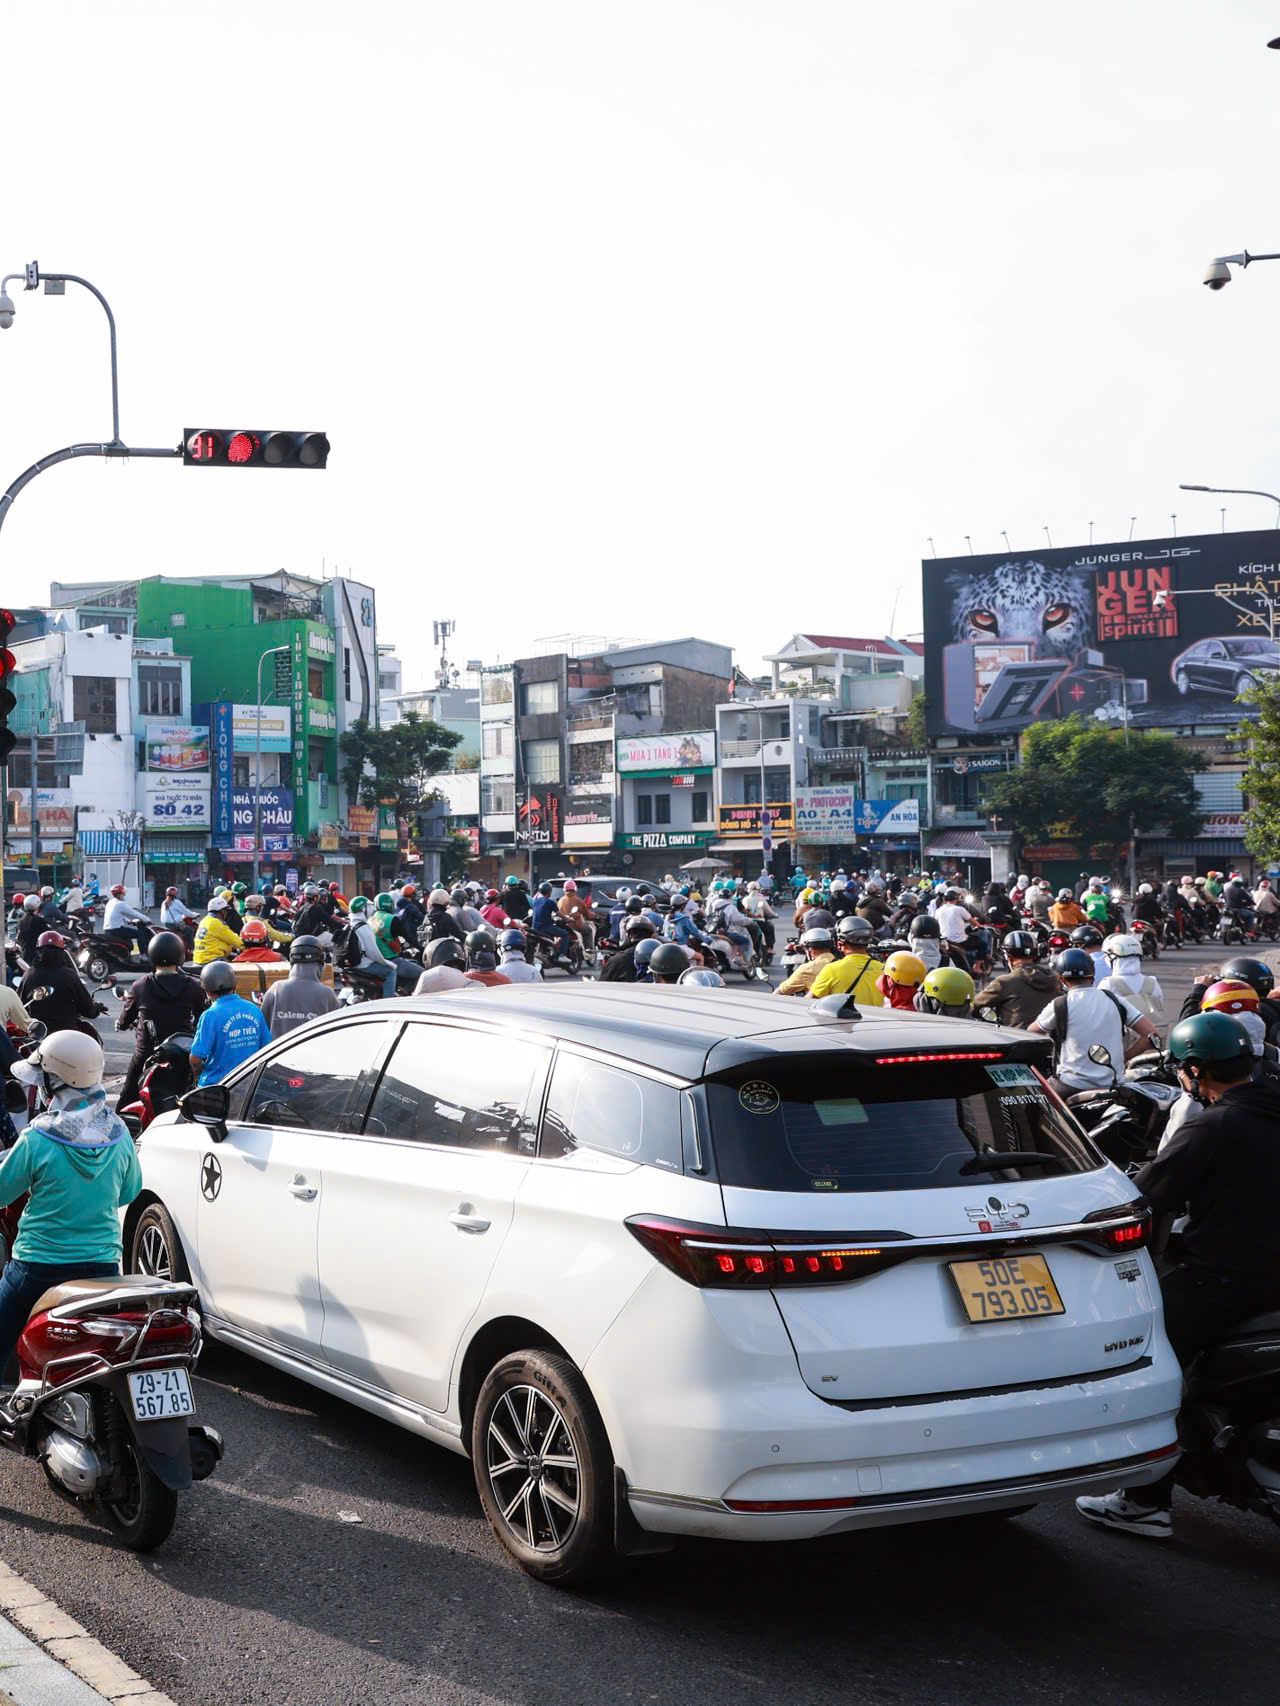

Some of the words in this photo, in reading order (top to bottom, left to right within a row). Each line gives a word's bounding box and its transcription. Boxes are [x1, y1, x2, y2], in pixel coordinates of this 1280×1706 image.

[1075, 552, 1143, 566] JUNGER
[1238, 562, 1274, 574] KÍCH
[1103, 620, 1157, 641] spirit
[219, 719, 228, 772] LONG
[630, 749, 645, 761] MUA
[971, 758, 1001, 768] SAIGON
[233, 794, 250, 805] NHÀ
[810, 796, 853, 808] PHOTOCOPY
[153, 801, 177, 816] SỐ
[181, 804, 205, 816] 42
[233, 810, 253, 824] NG
[262, 807, 292, 824] CHÂU
[829, 808, 853, 818] A4
[856, 817, 880, 829] Tiger
[890, 813, 901, 821] AN
[632, 836, 642, 846] THE
[643, 833, 667, 848] PIZZA
[668, 834, 696, 845] COMPANY
[978, 1259, 1025, 1287] 50E
[972, 1285, 1052, 1318] 793.05
[1104, 1340, 1128, 1352] BYD
[136, 1373, 180, 1395] 29-Z1
[136, 1393, 191, 1417] 567.85
